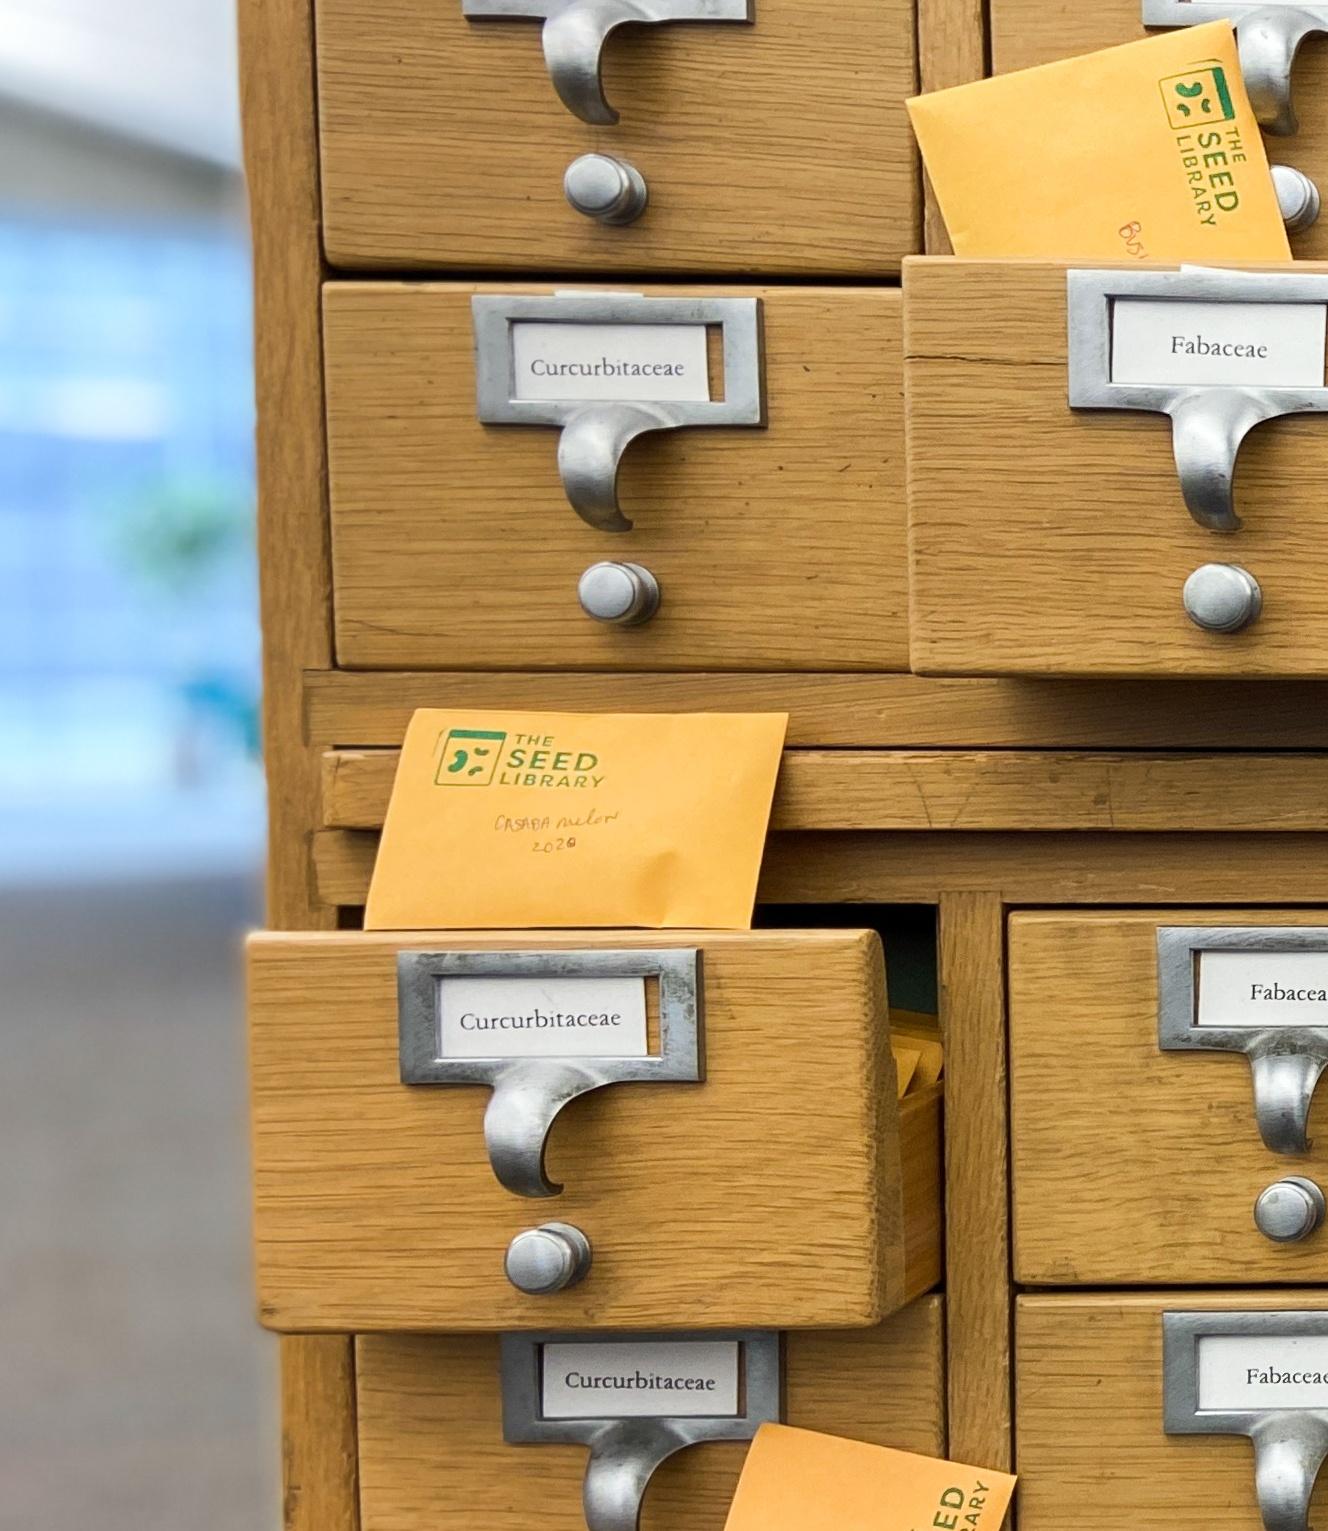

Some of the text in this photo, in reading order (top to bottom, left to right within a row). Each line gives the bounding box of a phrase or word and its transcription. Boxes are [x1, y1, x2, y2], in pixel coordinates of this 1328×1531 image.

[1226, 126, 1247, 162] THE
[1176, 135, 1217, 226] LIBRARY
[1197, 132, 1239, 212] SEED
[1171, 334, 1268, 359] Fabaceae
[530, 356, 684, 377] Curcurbitaceae
[515, 734, 555, 747] THE
[506, 749, 599, 772] SEED
[499, 772, 605, 788] LIBRARY
[459, 1008, 621, 1031] Curcurbitaceae
[565, 1370, 716, 1391] Curcurbitaceae
[961, 1480, 990, 1531] ARY
